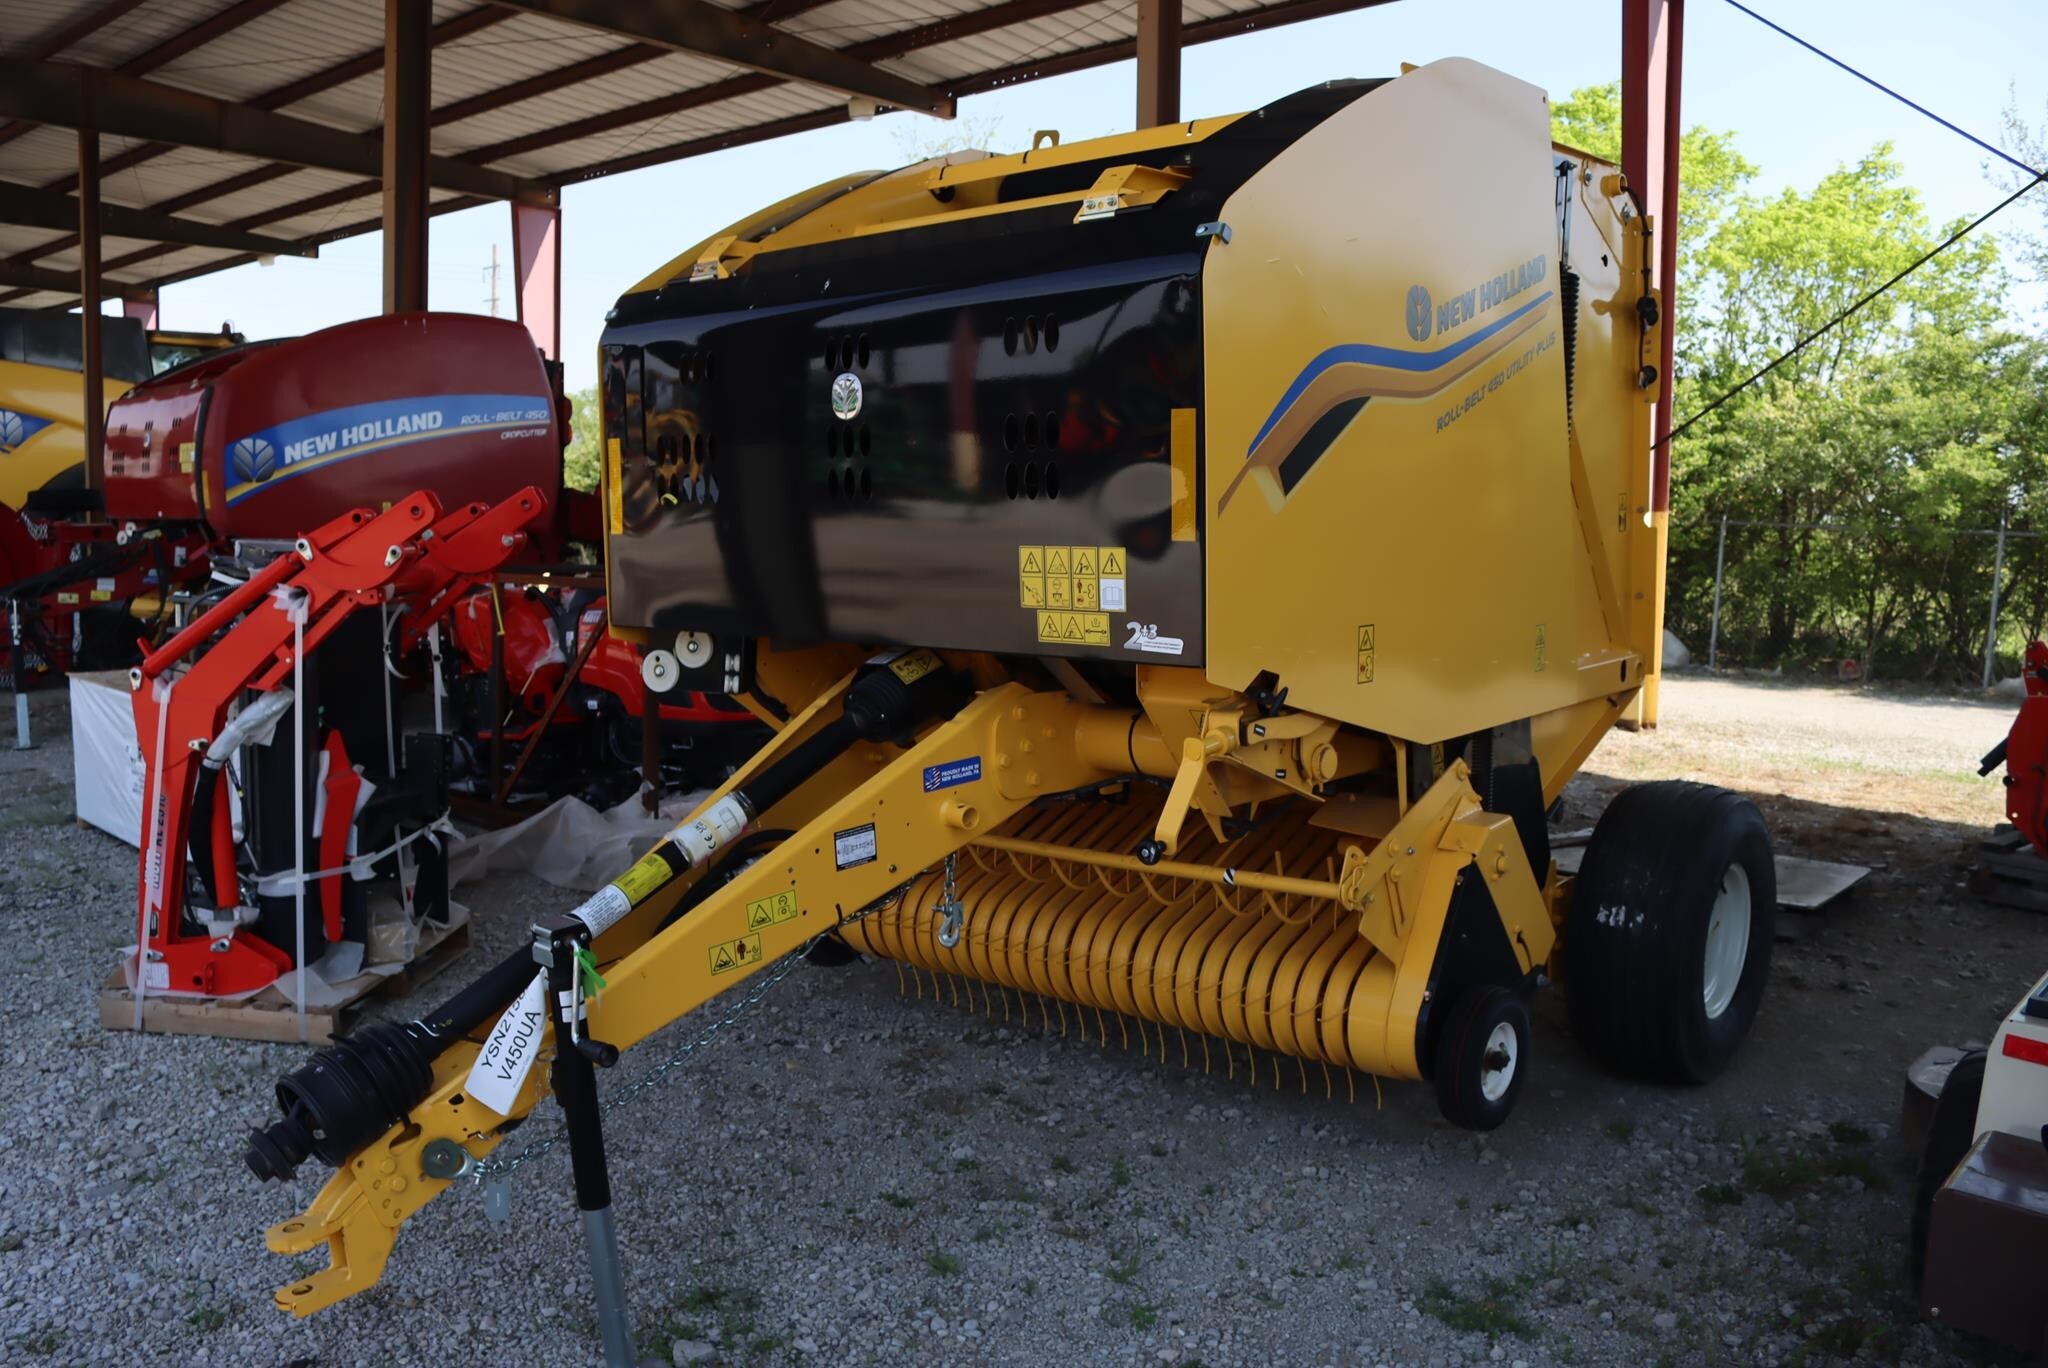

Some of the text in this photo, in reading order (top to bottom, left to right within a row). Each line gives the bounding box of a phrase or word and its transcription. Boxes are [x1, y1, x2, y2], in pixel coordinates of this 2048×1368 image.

[1437, 254, 1546, 335] NEW HOLLAND
[1436, 330, 1556, 432] ROLL-BELT 450 UTILITY PLUS
[284, 411, 443, 464] NEW HOLLAND
[461, 410, 548, 425] ROLL-BELT 450
[941, 769, 961, 777] PROUDLY
[497, 1010, 542, 1081] V450UA
